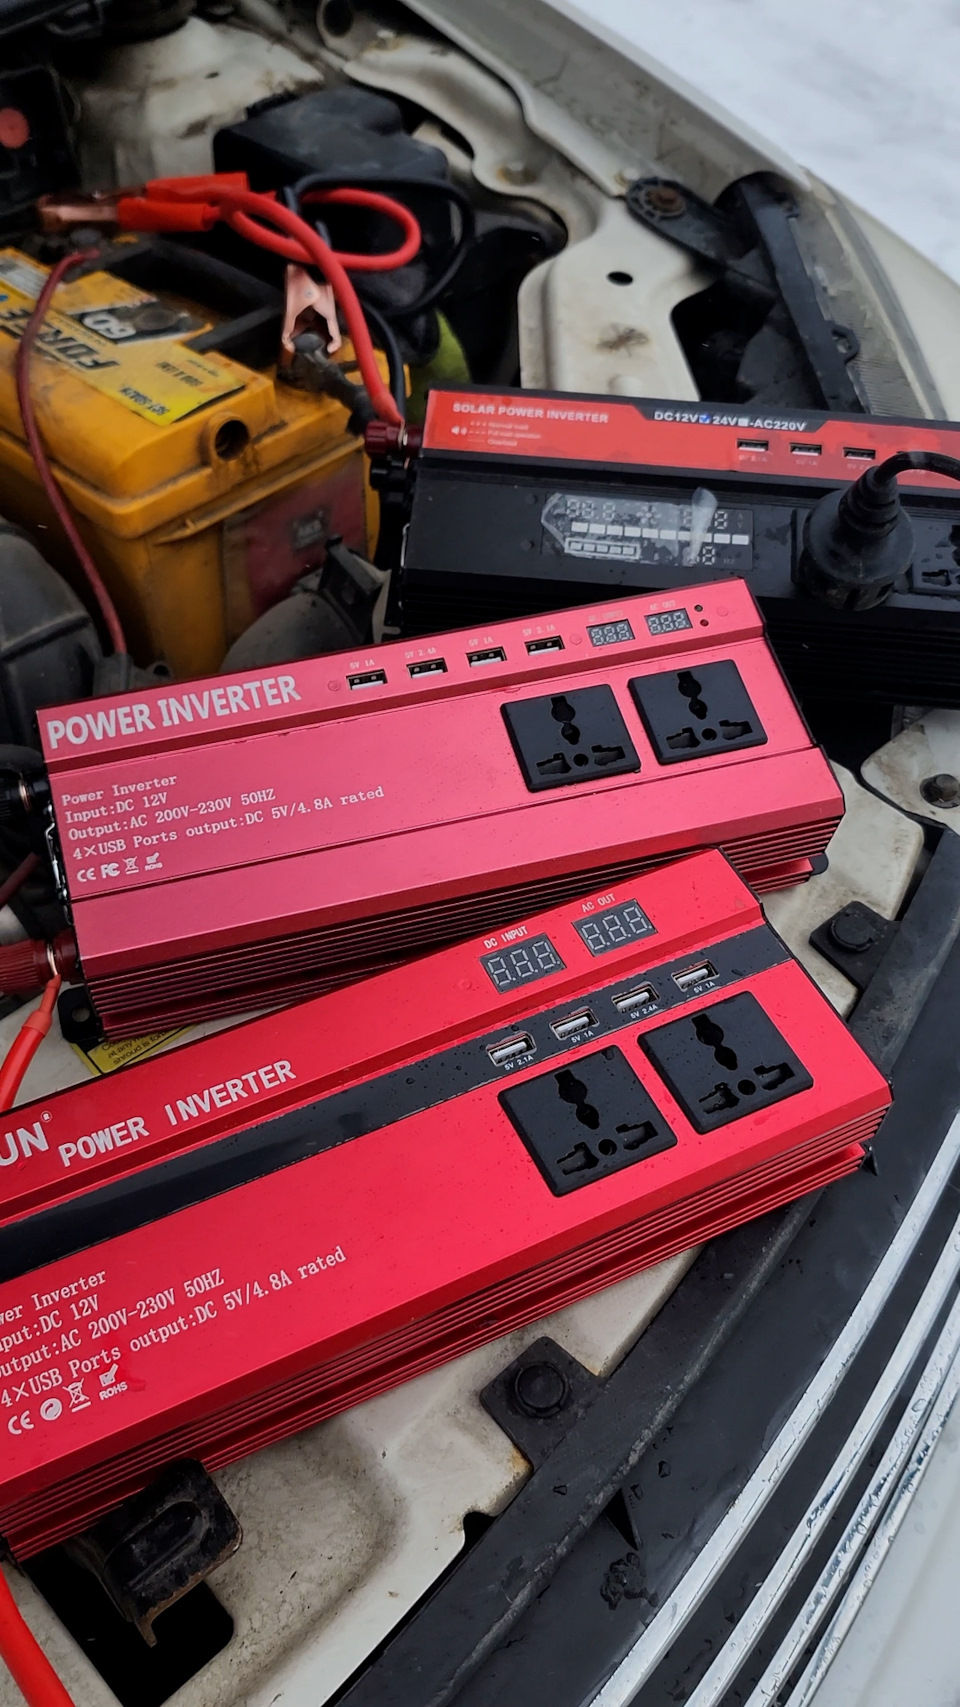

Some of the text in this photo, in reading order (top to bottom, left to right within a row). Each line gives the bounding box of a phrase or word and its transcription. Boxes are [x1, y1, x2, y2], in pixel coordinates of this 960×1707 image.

[453, 402, 609, 423] SOLAR POWER INVERTER
[654, 410, 699, 423] DC12V
[350, 658, 376, 669] 5V 1A
[47, 675, 302, 750] POWER INVERTER
[62, 775, 177, 806] Power Inverter
[65, 792, 168, 824] Input:DC 12V
[68, 788, 276, 841] Output:AC 200V-230V 50HZ
[133, 830, 178, 848] Ports
[186, 810, 264, 837] output:DC
[271, 797, 333, 820] 5V/4.8A
[340, 785, 385, 805] rated
[581, 893, 616, 913] AC OUT
[484, 925, 529, 949] DC INPUT
[693, 980, 716, 994] 5V 1A
[630, 1003, 659, 1020] 5V 2.4A
[571, 1030, 595, 1044] 5V 1A
[504, 1054, 535, 1071] 5V 2.1A
[58, 1116, 150, 1167] POWER
[165, 1060, 297, 1126] INVERTER
[31, 1270, 106, 1311] Inverter
[68, 1346, 121, 1379] Ports
[129, 1301, 218, 1353] output:DC
[223, 1269, 293, 1312] 5V/4.8A
[298, 1245, 347, 1280] rated
[70, 1294, 99, 1320] 12V
[0, 1268, 225, 1378] utput:AC 200V-230V 50HZ
[99, 1381, 128, 1400] ROHS
[8, 1410, 34, 1435] CE
